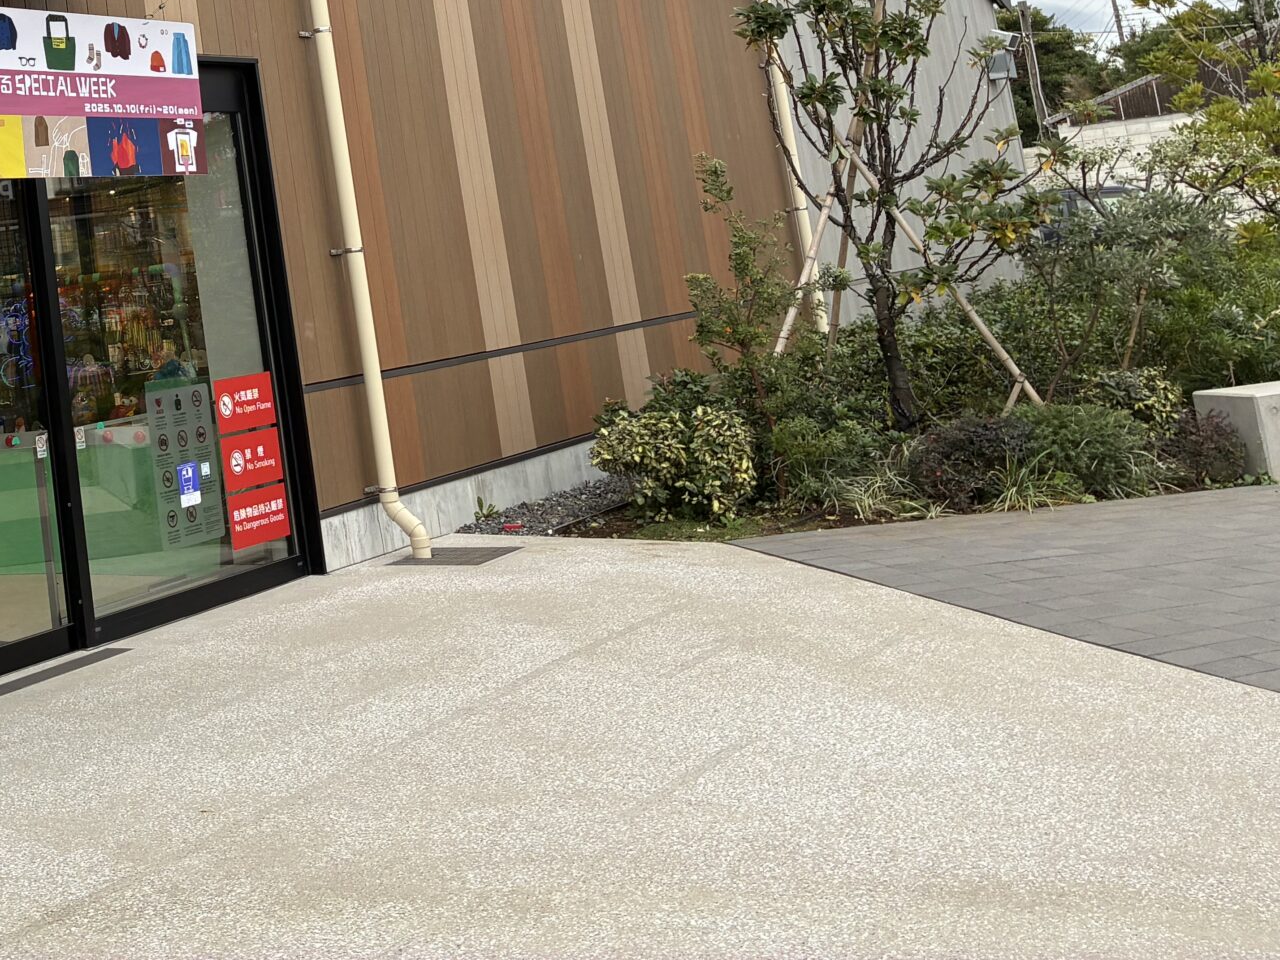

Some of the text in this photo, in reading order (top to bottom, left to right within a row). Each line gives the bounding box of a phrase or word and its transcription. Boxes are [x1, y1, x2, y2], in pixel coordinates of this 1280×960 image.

[15, 74, 76, 97] SPECIAL
[76, 76, 117, 98] WEEK
[235, 401, 271, 414] No Open Flame
[246, 458, 275, 470] No Smoking
[235, 512, 285, 532] No Dangerous Goods
